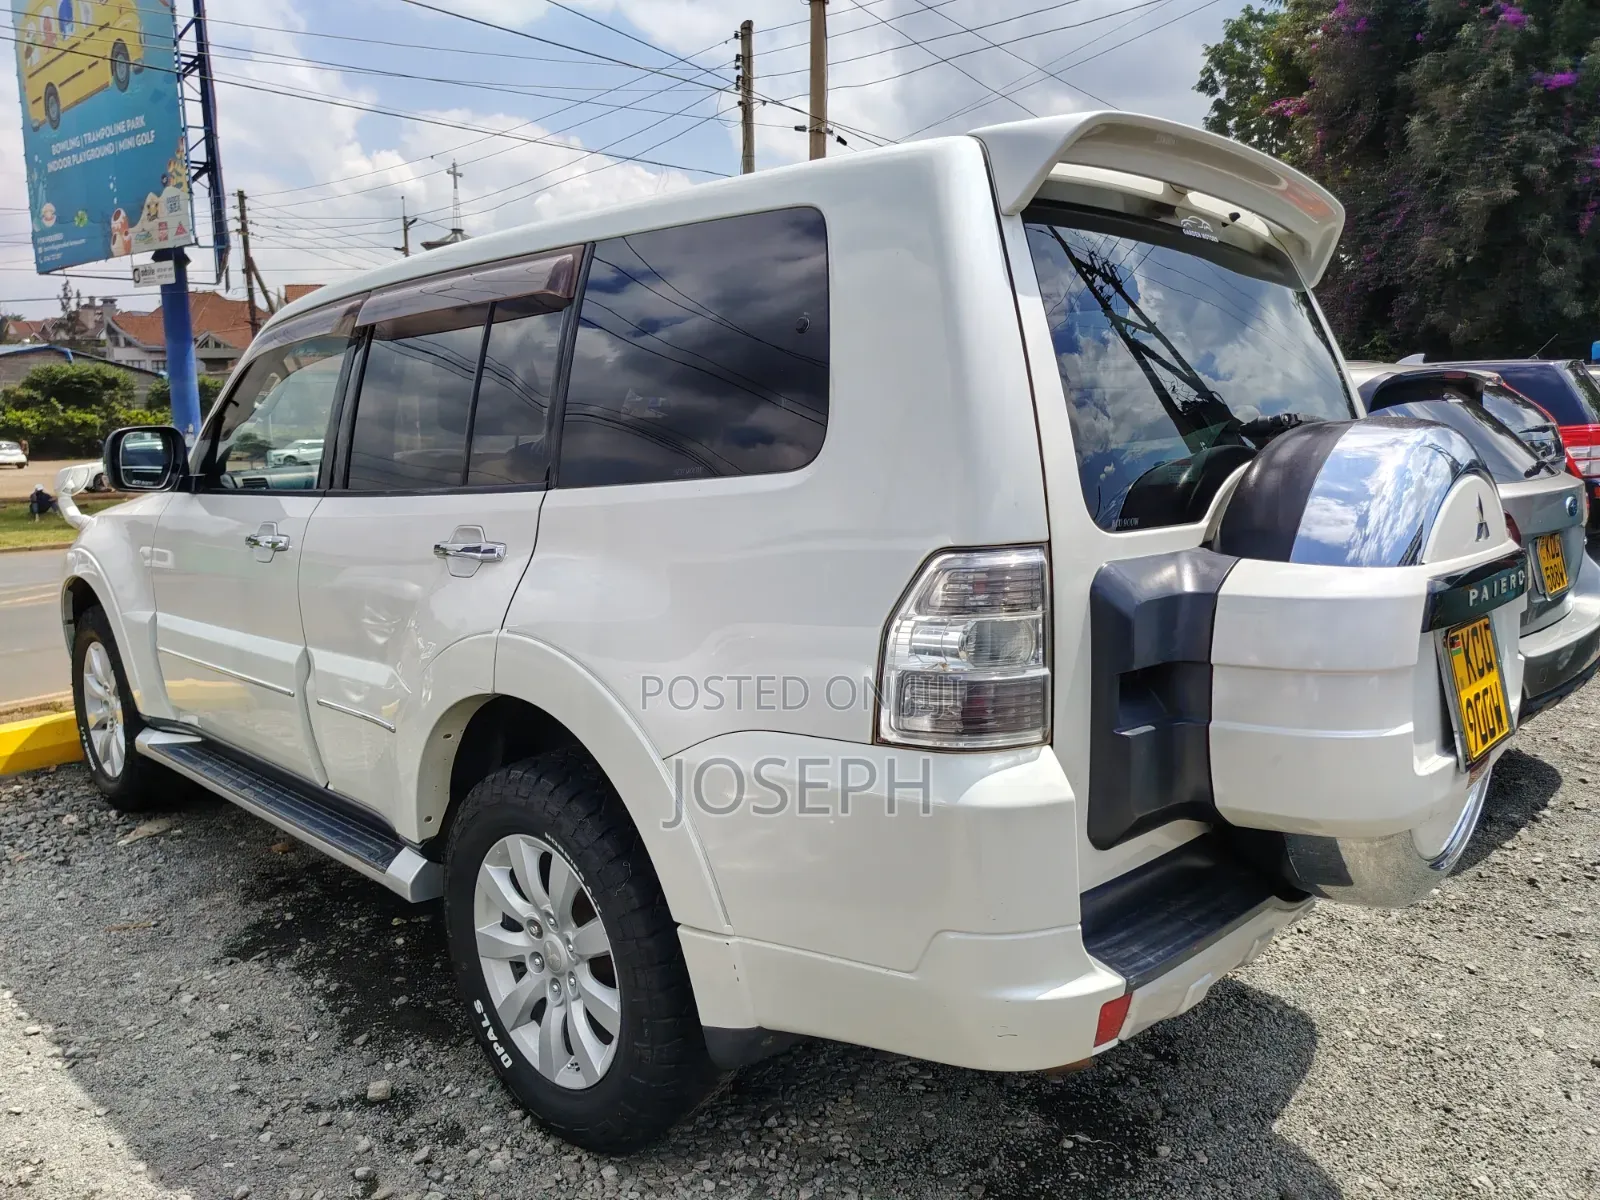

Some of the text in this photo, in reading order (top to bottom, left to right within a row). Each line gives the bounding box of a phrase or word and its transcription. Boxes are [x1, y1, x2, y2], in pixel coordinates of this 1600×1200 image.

[47, 156, 73, 173] INDOOR
[71, 142, 115, 166] PLAYGROUND
[118, 136, 136, 152] MINI
[135, 129, 156, 147] GOLF
[51, 135, 80, 156] BOWLING
[83, 120, 127, 145] TRAMPOLINE
[126, 114, 146, 132] PARK
[1465, 681, 1505, 752] 900W
[474, 999, 513, 1069] OPALS
